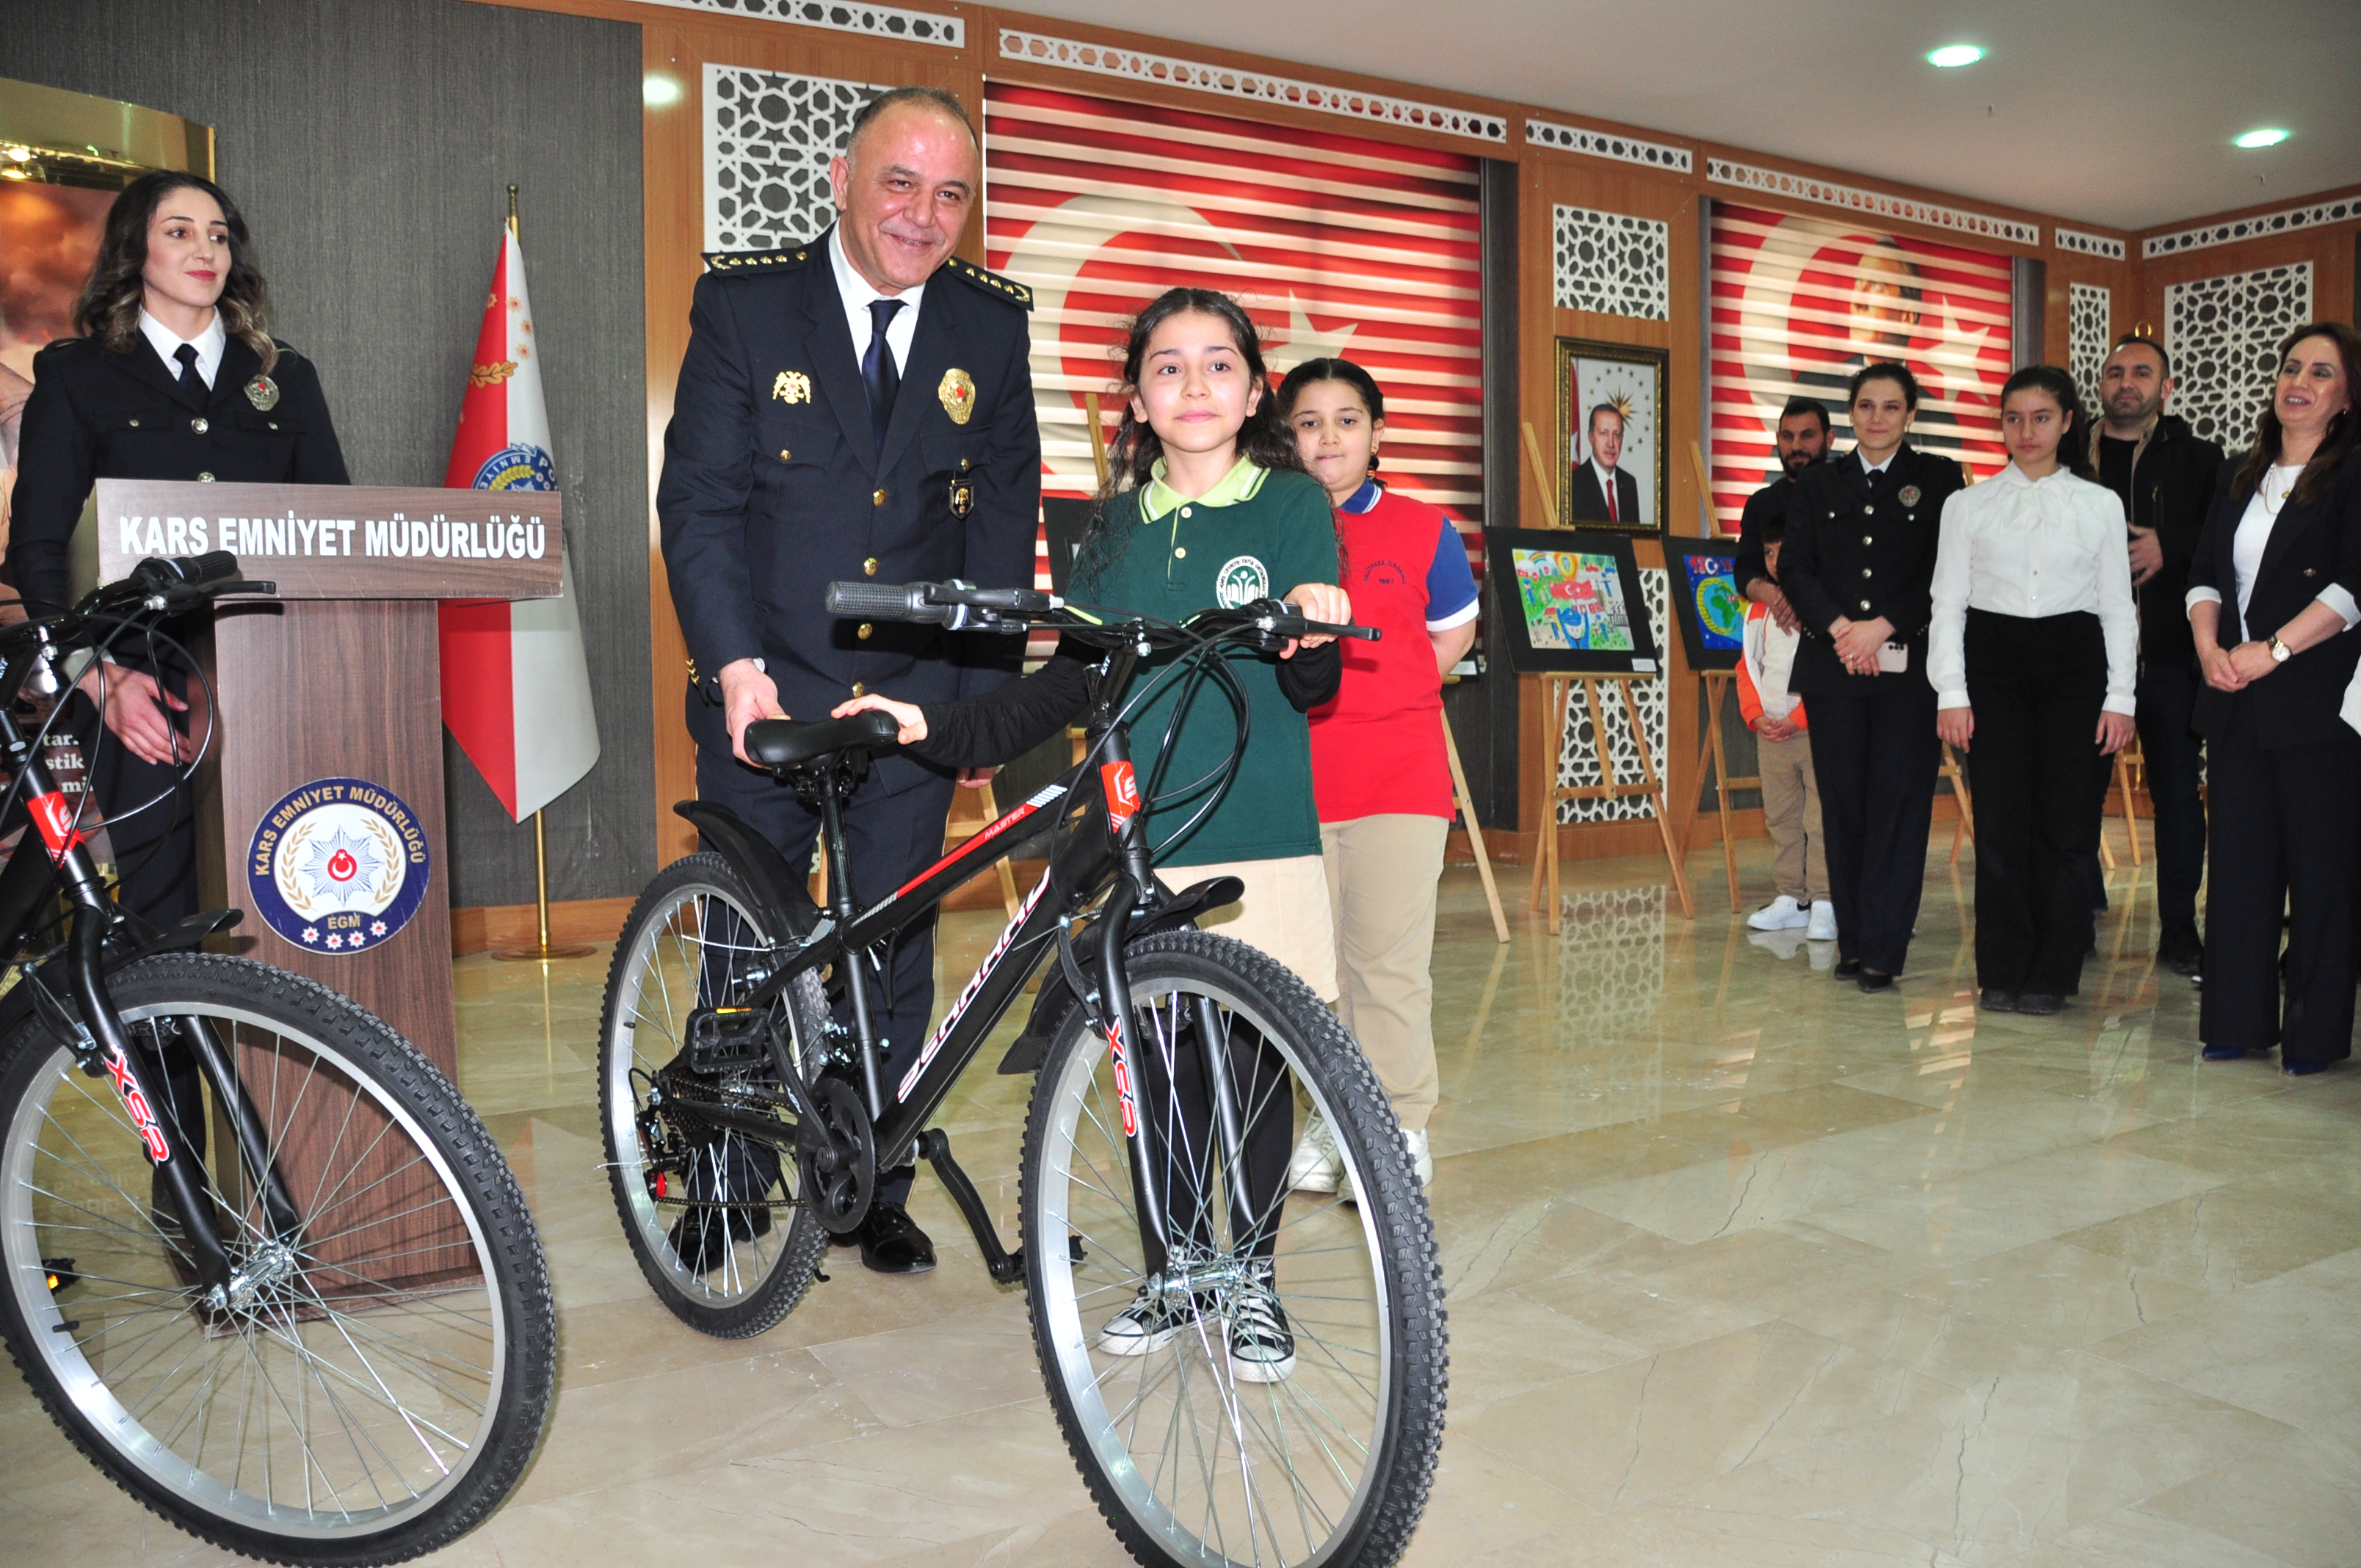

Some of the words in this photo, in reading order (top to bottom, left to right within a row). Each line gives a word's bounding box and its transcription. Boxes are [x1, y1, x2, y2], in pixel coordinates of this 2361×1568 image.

[119, 515, 209, 556] KARS
[220, 509, 356, 557] EMNİYET
[365, 512, 546, 560] MÜDÜRLÜĞÜ
[45, 752, 86, 770] stik
[255, 829, 278, 876] KARS
[271, 785, 344, 830] EMNİYET
[349, 785, 427, 864] MÜDÜRLÜĞÜ
[984, 807, 1026, 841] MASTER
[327, 915, 361, 930] EGM
[101, 1043, 170, 1169] XSR
